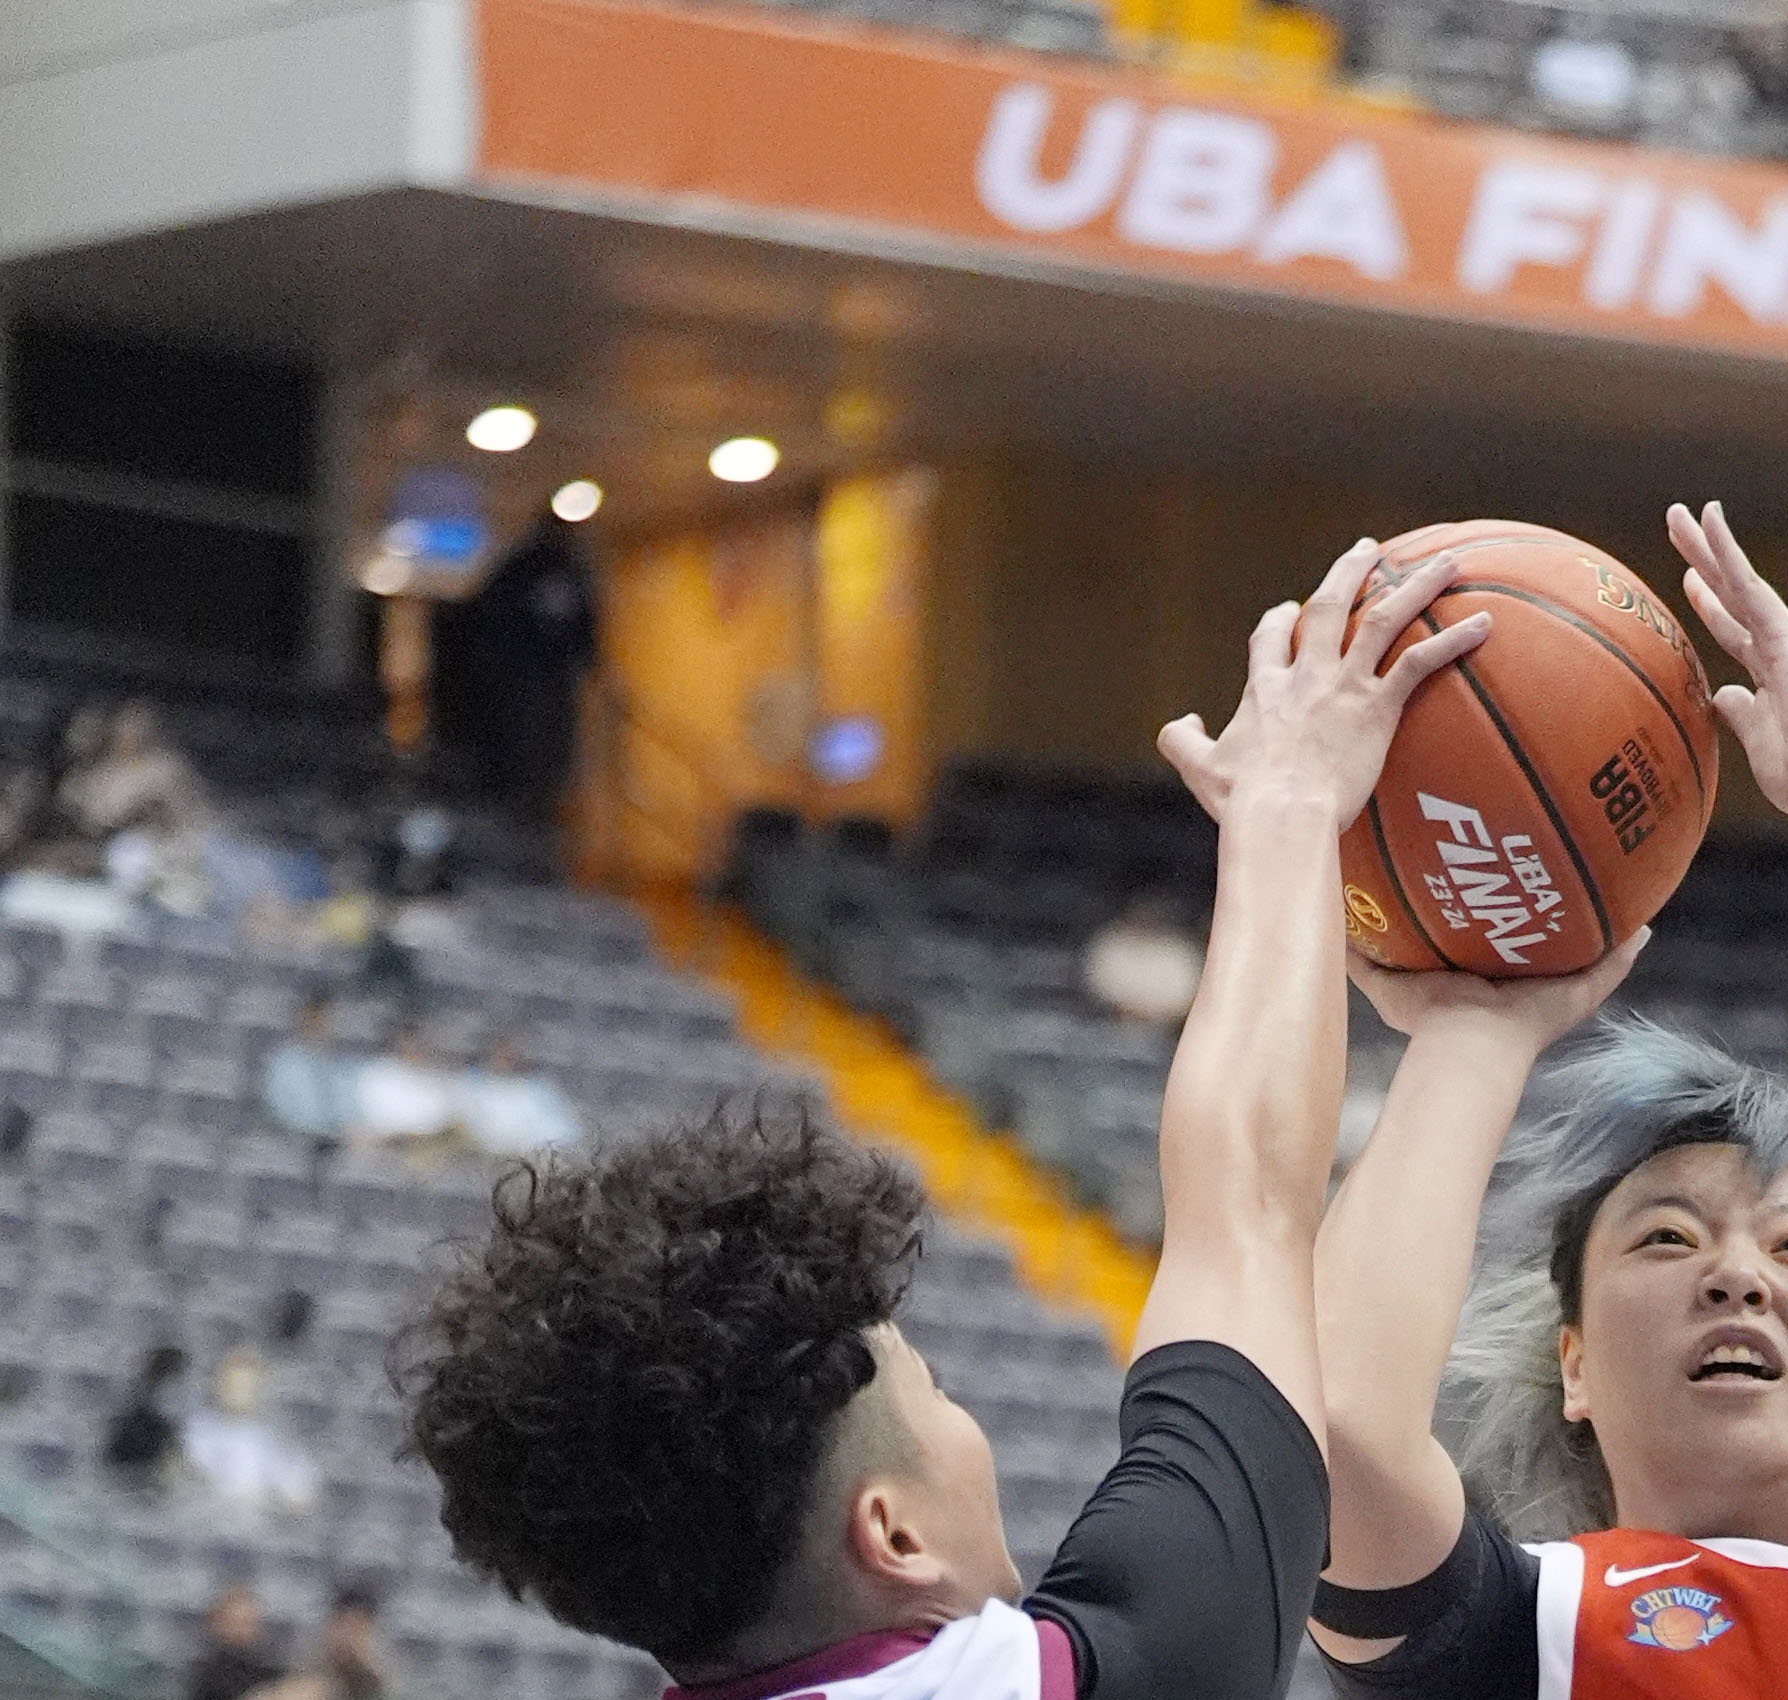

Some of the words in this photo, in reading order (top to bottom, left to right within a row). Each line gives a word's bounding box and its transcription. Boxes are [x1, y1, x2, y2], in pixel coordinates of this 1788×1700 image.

[976, 83, 1408, 285] UBA
[1590, 754, 1656, 856] FIBA
[1416, 791, 1548, 964] FINAL
[1501, 834, 1563, 914] UBA
